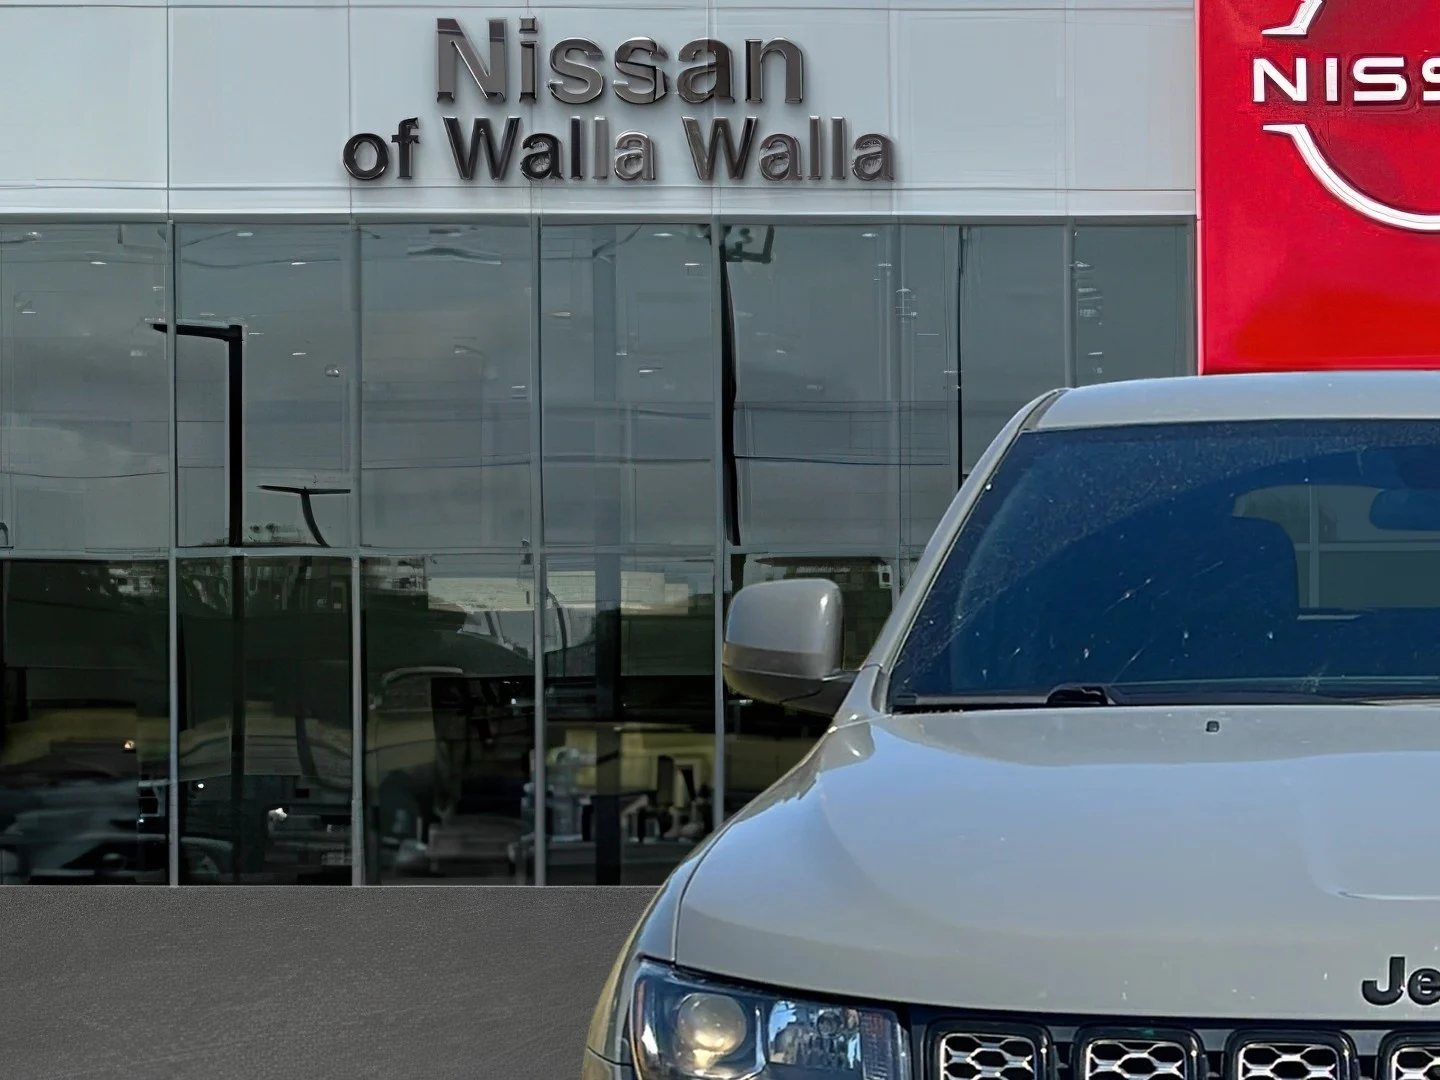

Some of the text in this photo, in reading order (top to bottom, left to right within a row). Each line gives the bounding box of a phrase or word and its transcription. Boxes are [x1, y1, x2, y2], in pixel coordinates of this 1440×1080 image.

[436, 16, 804, 104] Nissan
[342, 116, 895, 181] of Walla Walla
